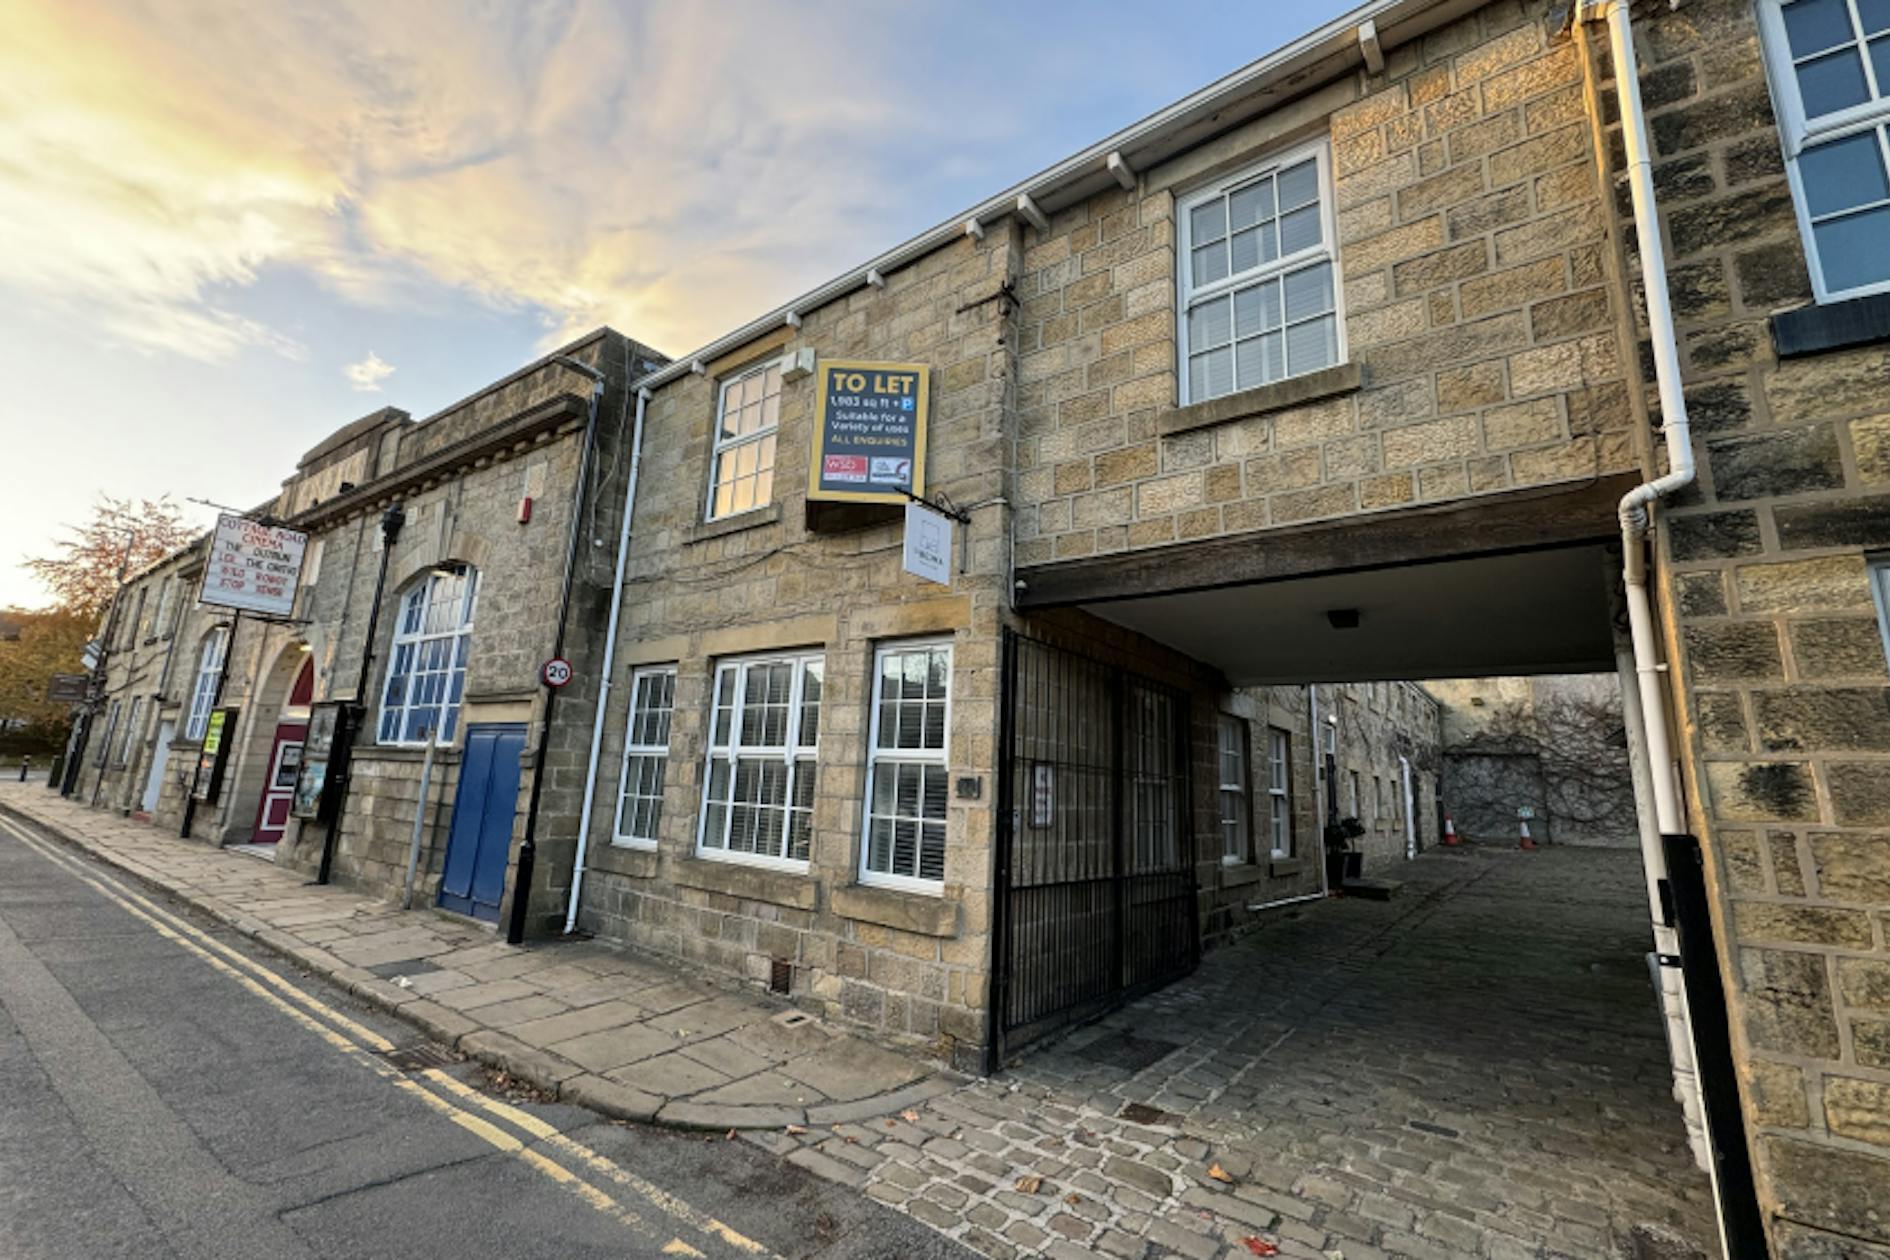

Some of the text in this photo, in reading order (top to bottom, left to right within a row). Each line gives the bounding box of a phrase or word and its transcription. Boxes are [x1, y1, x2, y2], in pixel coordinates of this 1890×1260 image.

[833, 373, 914, 394] TO LET
[835, 410, 875, 420] Suitable
[881, 412, 896, 422] for
[831, 421, 909, 434] Variety of uses
[831, 434, 907, 447] ALL ENQUIRIES
[242, 534, 283, 549] CINEMA
[276, 531, 306, 544] ROAD
[246, 558, 264, 569] THE
[549, 666, 567, 679] 20
